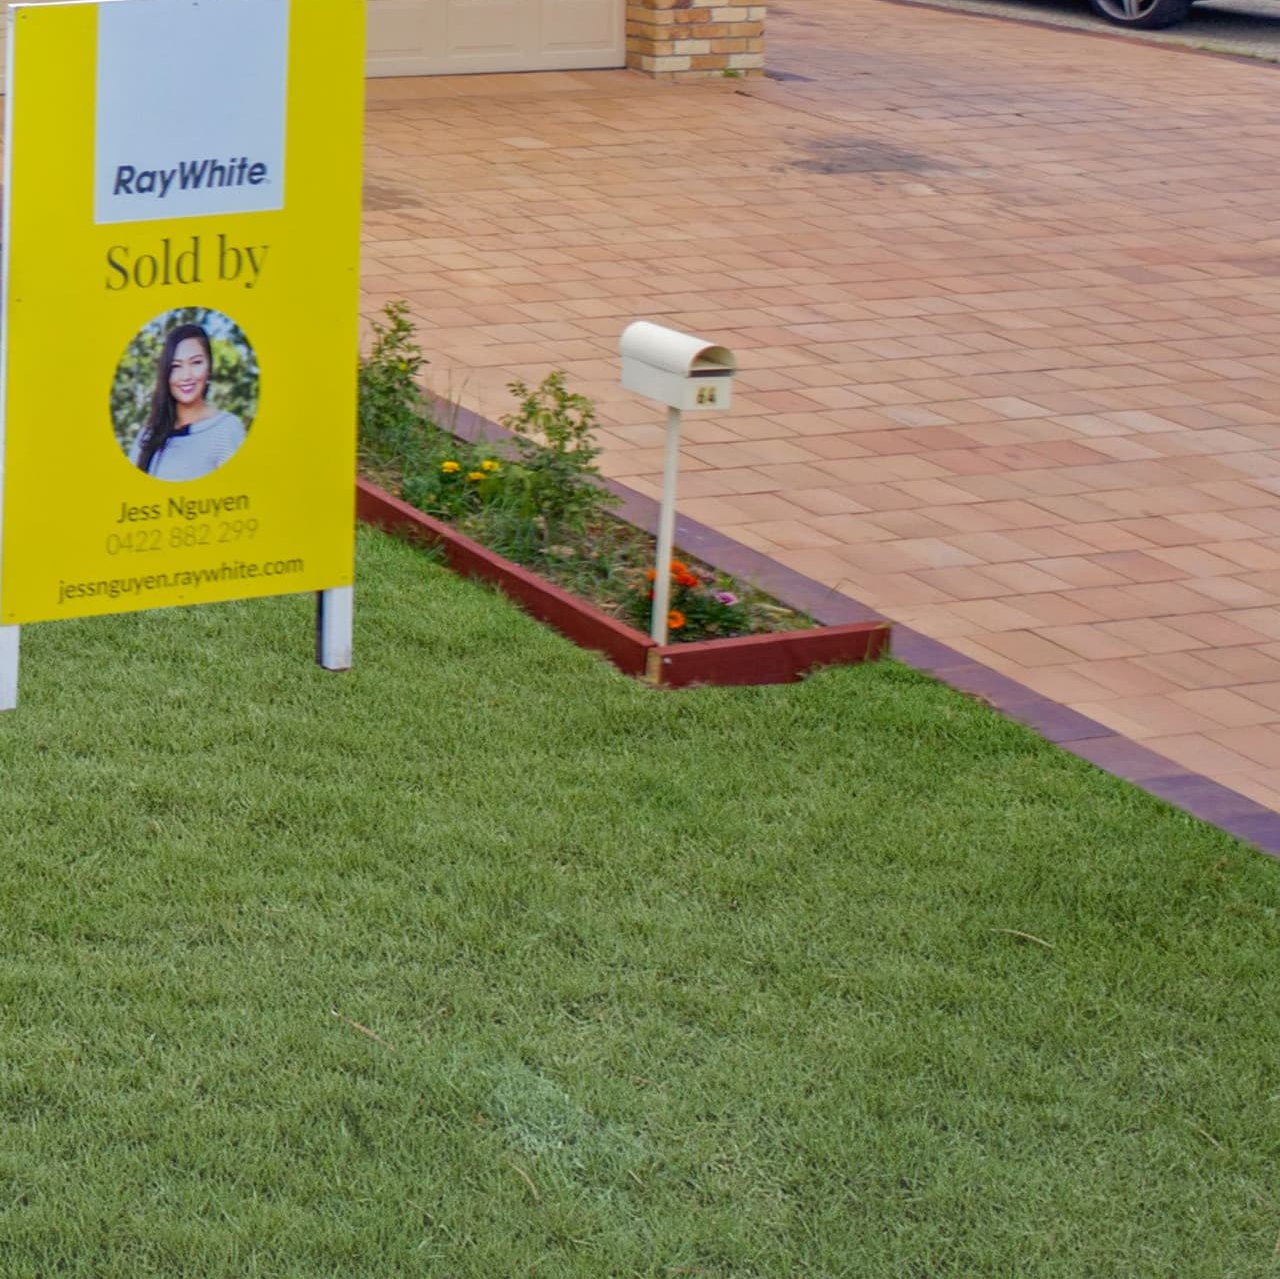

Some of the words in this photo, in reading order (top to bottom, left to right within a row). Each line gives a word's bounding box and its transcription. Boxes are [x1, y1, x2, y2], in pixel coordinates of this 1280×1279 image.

[105, 235, 203, 291] Sold
[217, 233, 271, 289] by
[117, 502, 160, 524] Jess
[167, 494, 249, 521] Nguyen
[106, 529, 162, 555] 0422
[169, 523, 211, 549] 882
[57, 558, 304, 605] jessnguyen.raywhite.com
